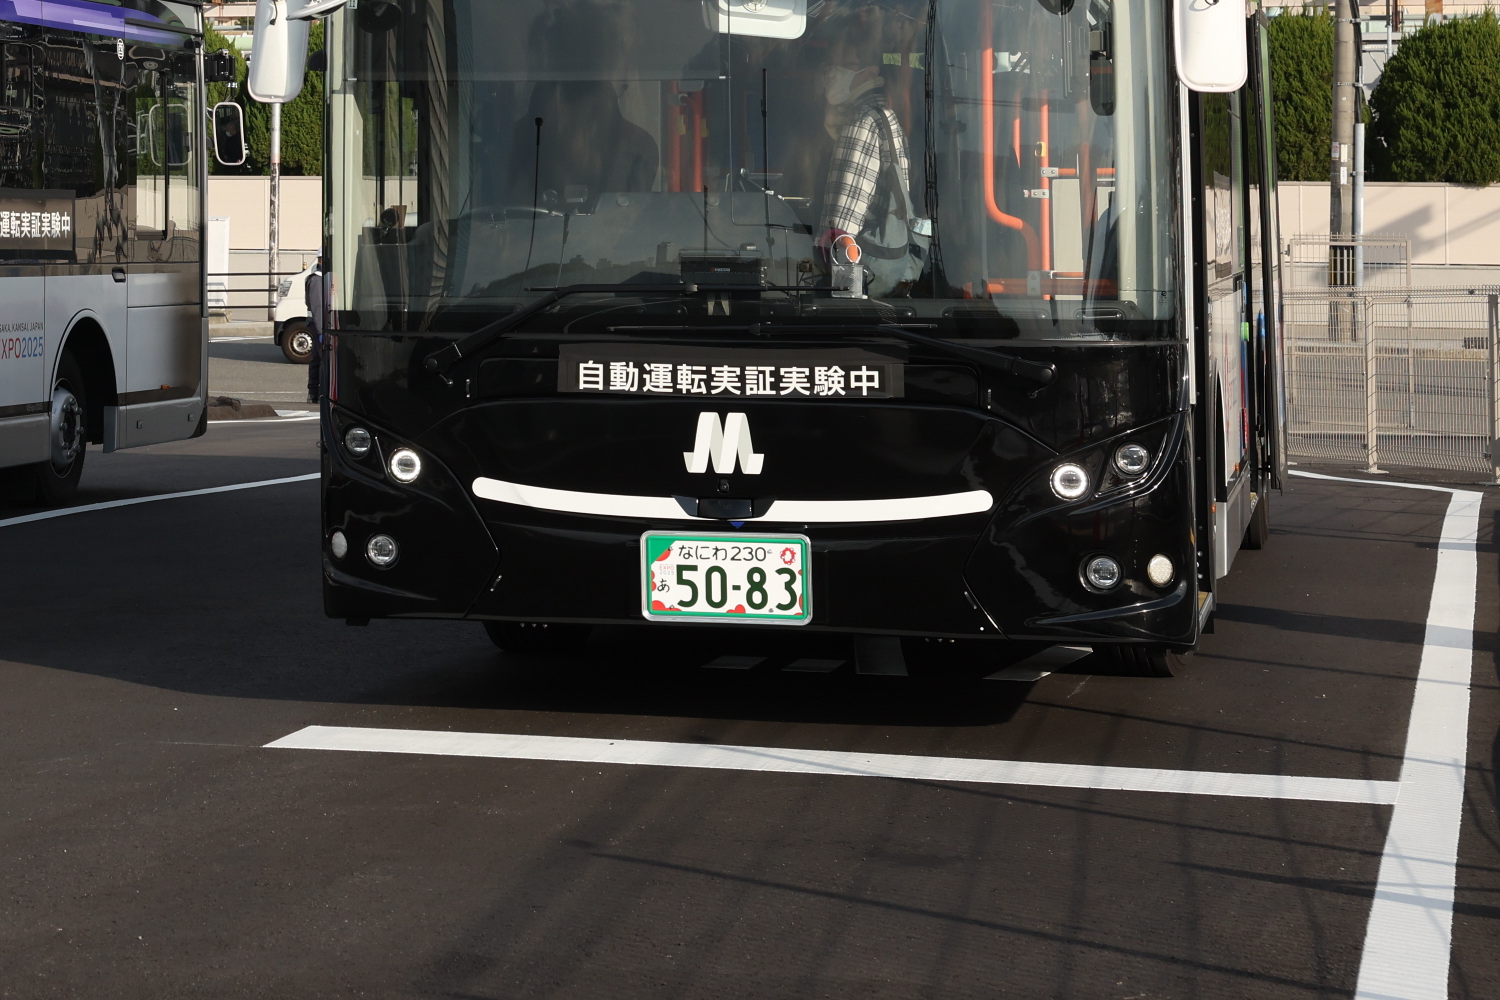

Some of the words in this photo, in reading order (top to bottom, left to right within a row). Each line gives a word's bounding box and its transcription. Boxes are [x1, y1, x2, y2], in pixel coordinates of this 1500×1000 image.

[12, 322, 30, 332] KANSAI,
[30, 321, 44, 331] JAPAN
[578, 360, 881, 397] 自動運転実証実験中
[657, 578, 671, 593] あ
[676, 564, 798, 611] 50-83
